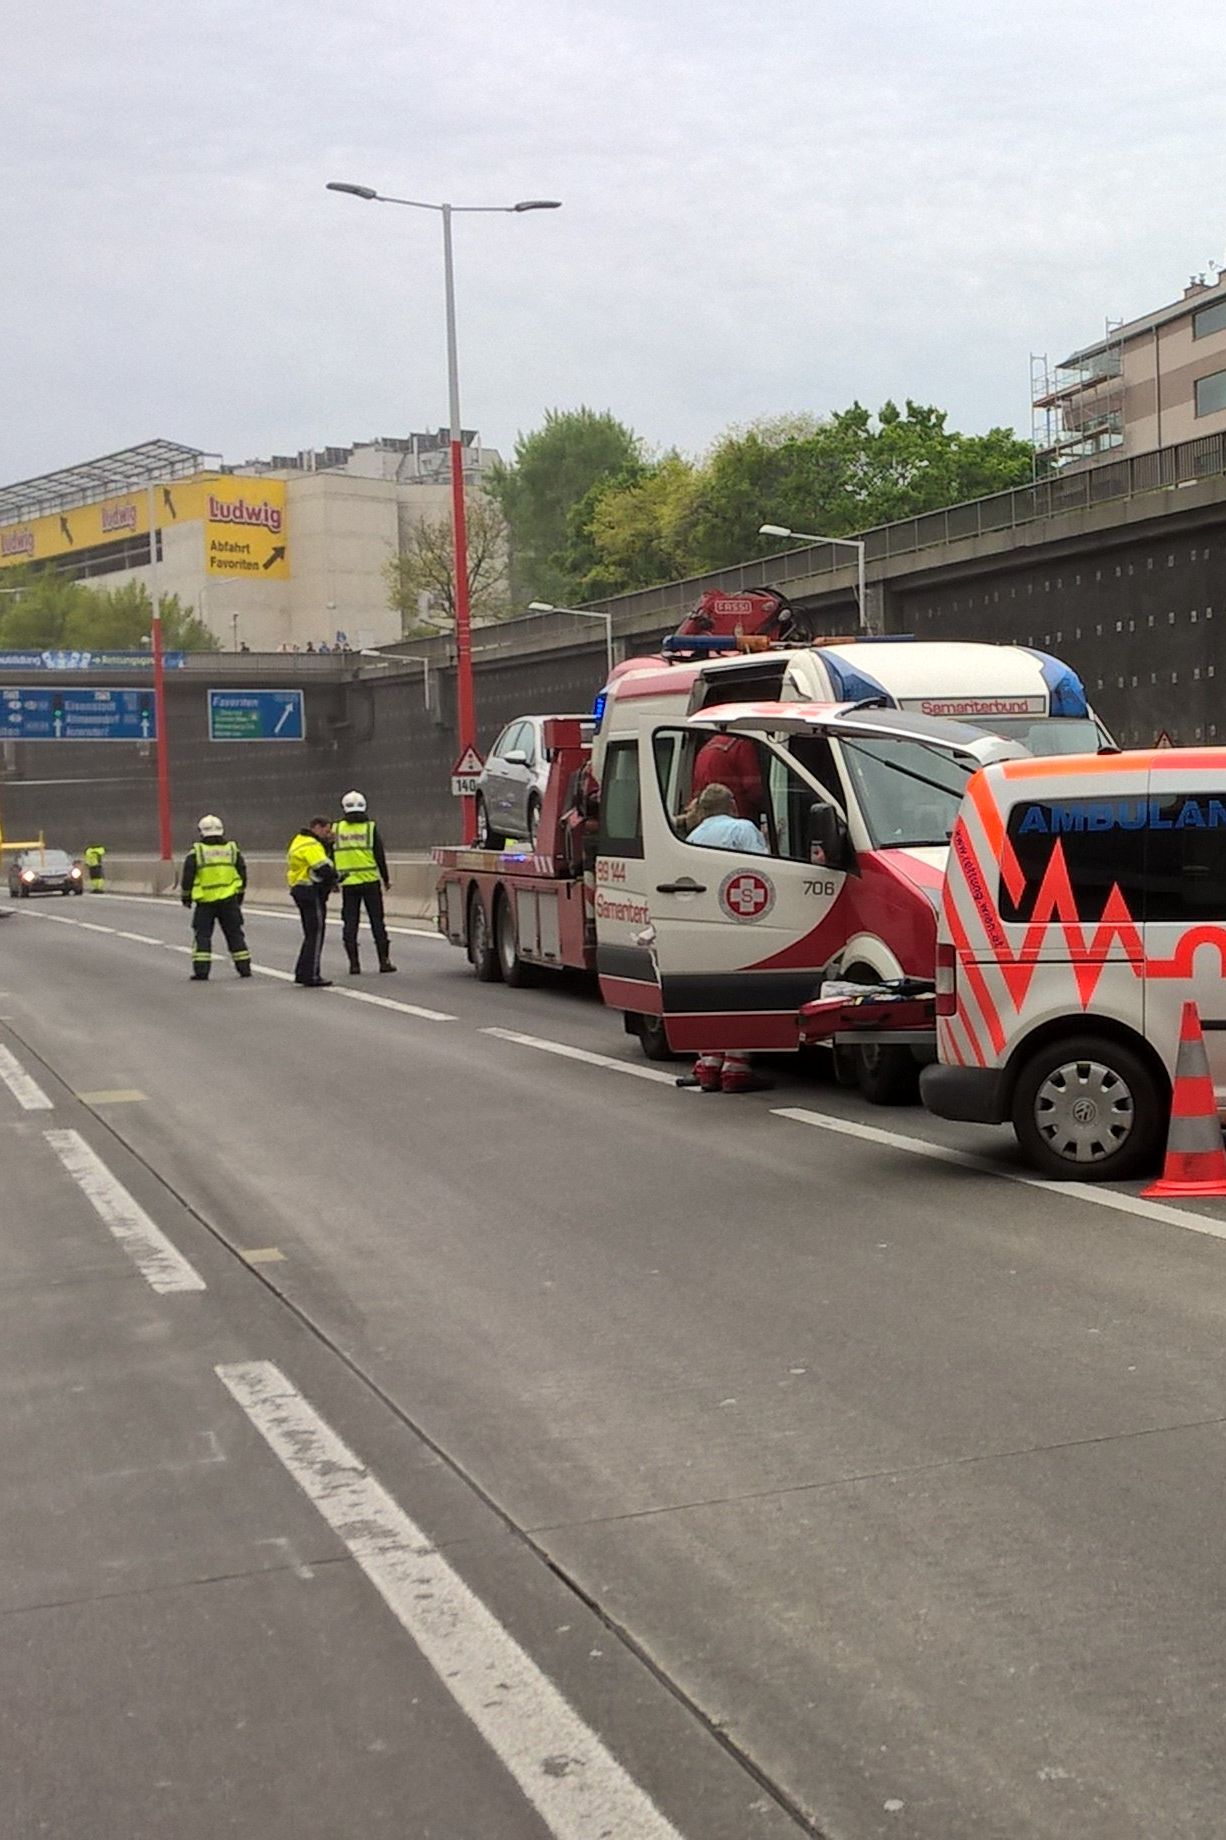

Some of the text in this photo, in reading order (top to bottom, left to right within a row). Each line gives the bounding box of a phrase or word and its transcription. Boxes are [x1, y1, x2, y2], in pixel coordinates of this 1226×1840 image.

[208, 495, 282, 532] Ludwig
[210, 540, 250, 554] Abfahrt
[210, 556, 259, 570] Favoriten
[921, 700, 1029, 714] Samariterbund
[457, 779, 476, 792] 140
[611, 861, 626, 883] 144
[803, 880, 835, 896] 706
